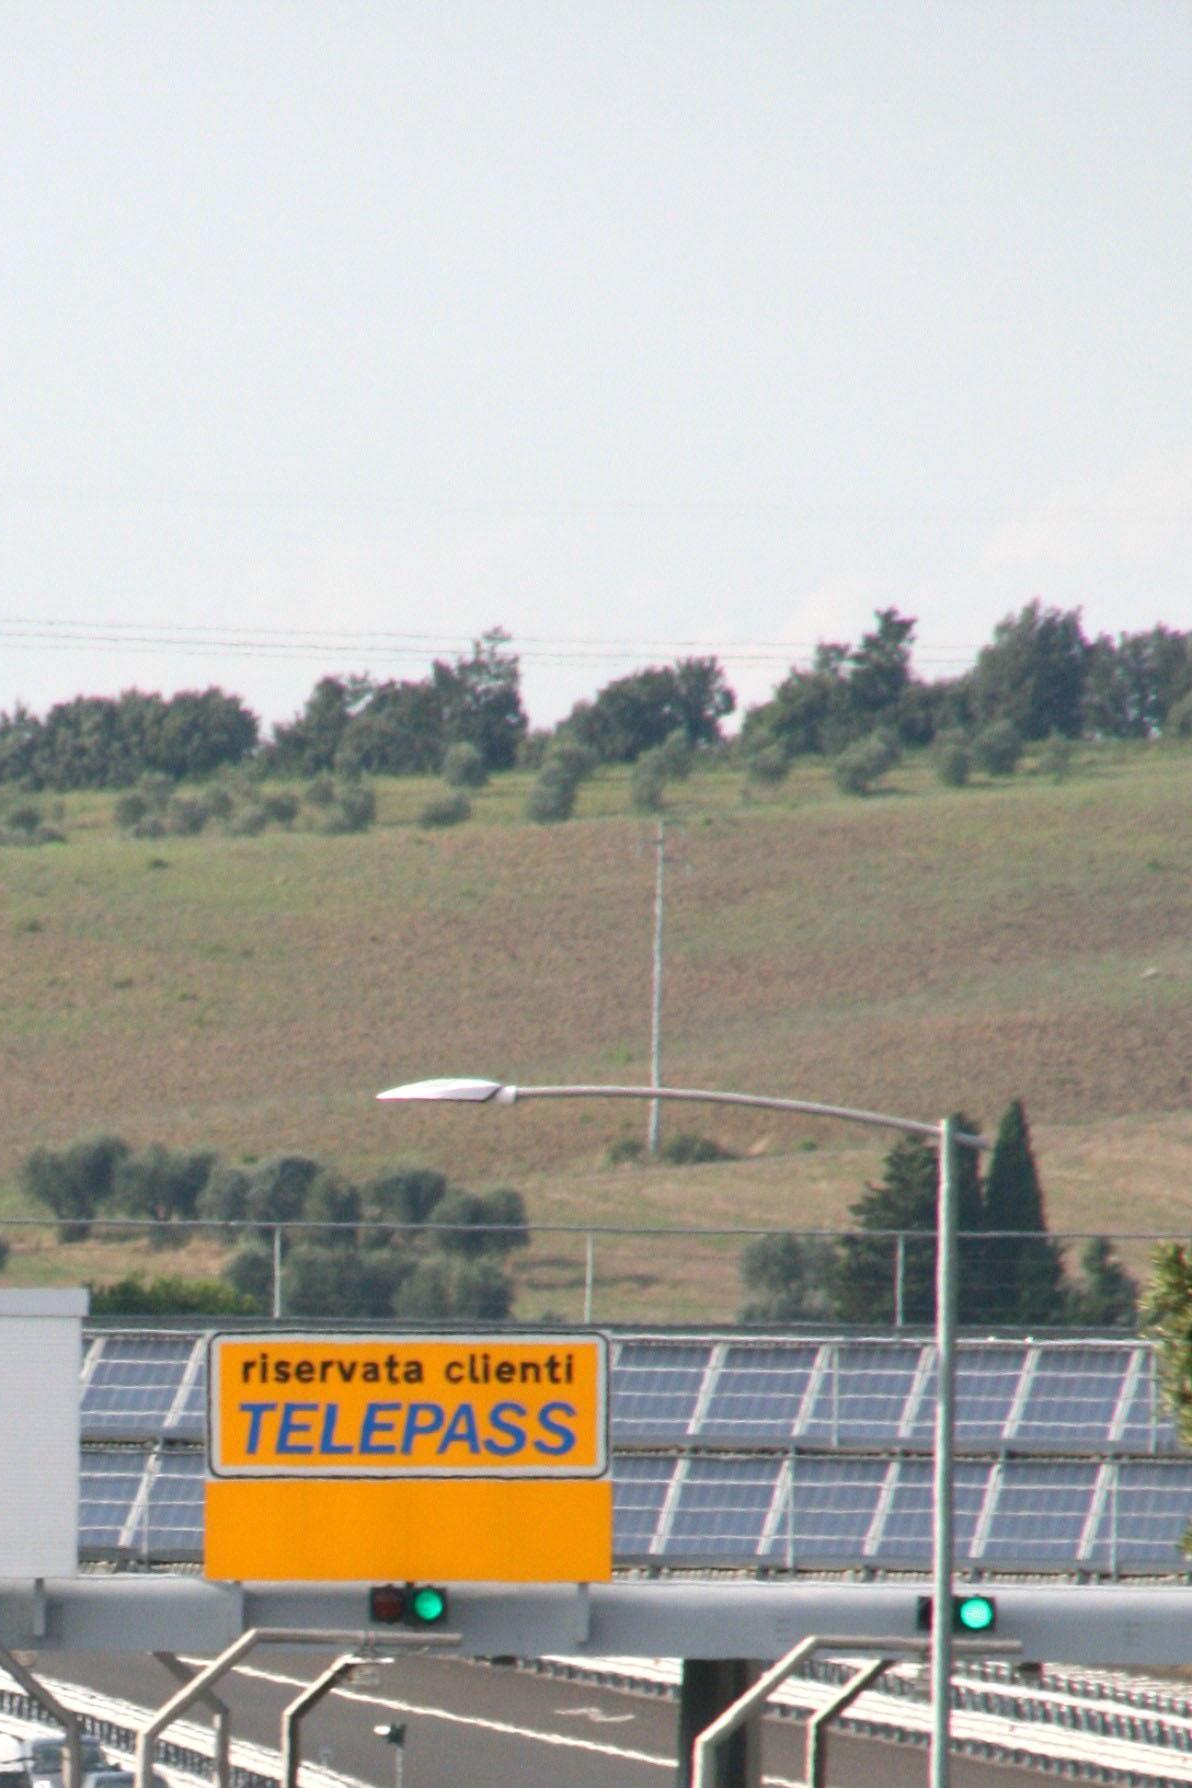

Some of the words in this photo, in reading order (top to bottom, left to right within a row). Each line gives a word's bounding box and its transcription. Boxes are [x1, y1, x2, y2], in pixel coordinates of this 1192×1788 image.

[241, 1353, 424, 1384] riservata
[445, 1353, 575, 1384] clienti
[239, 1402, 577, 1456] TELEPASS
